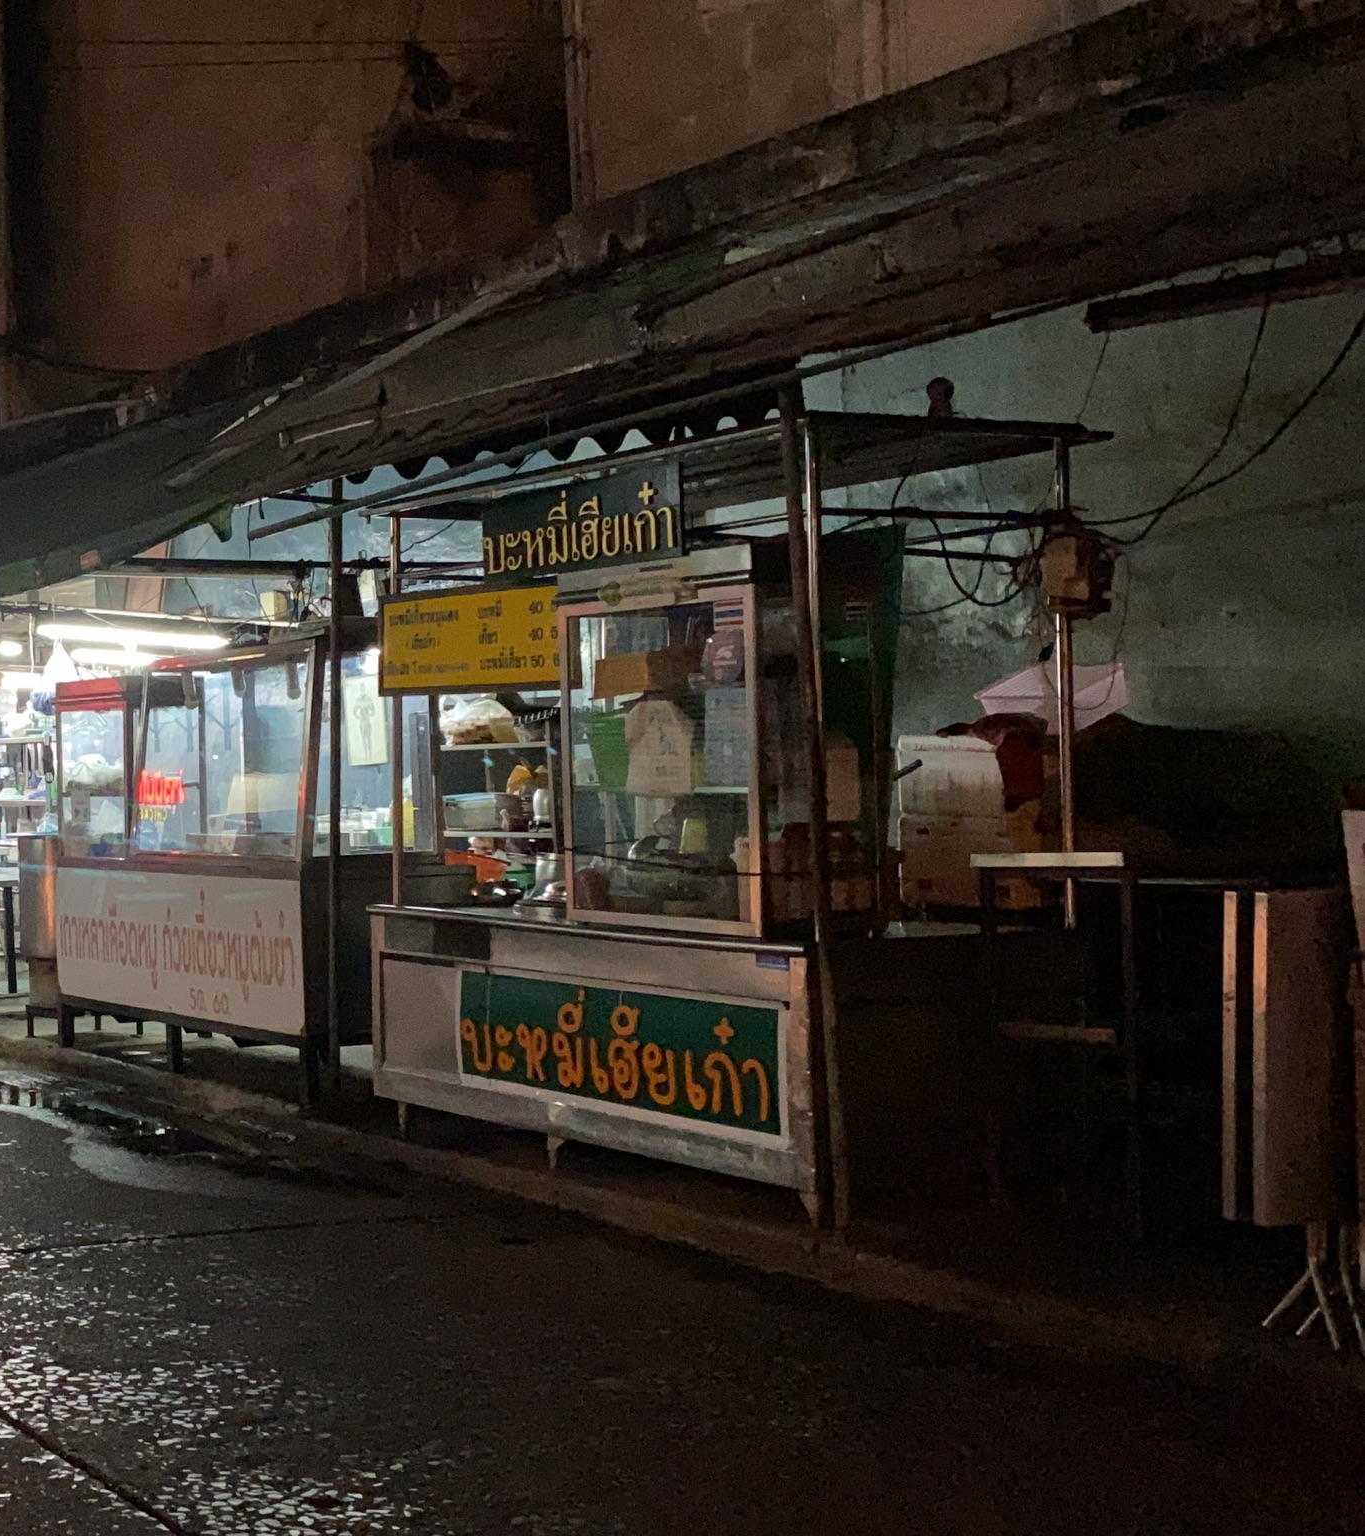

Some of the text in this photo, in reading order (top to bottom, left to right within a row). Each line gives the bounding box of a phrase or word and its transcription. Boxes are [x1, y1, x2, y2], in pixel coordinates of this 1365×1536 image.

[484, 481, 674, 574] บะหมี่เฮียเก๋า
[529, 601, 544, 614] 40
[529, 627, 544, 641] 40
[530, 654, 545, 668] 50
[460, 986, 769, 1121] บะหมี่เฮียเก๋า
